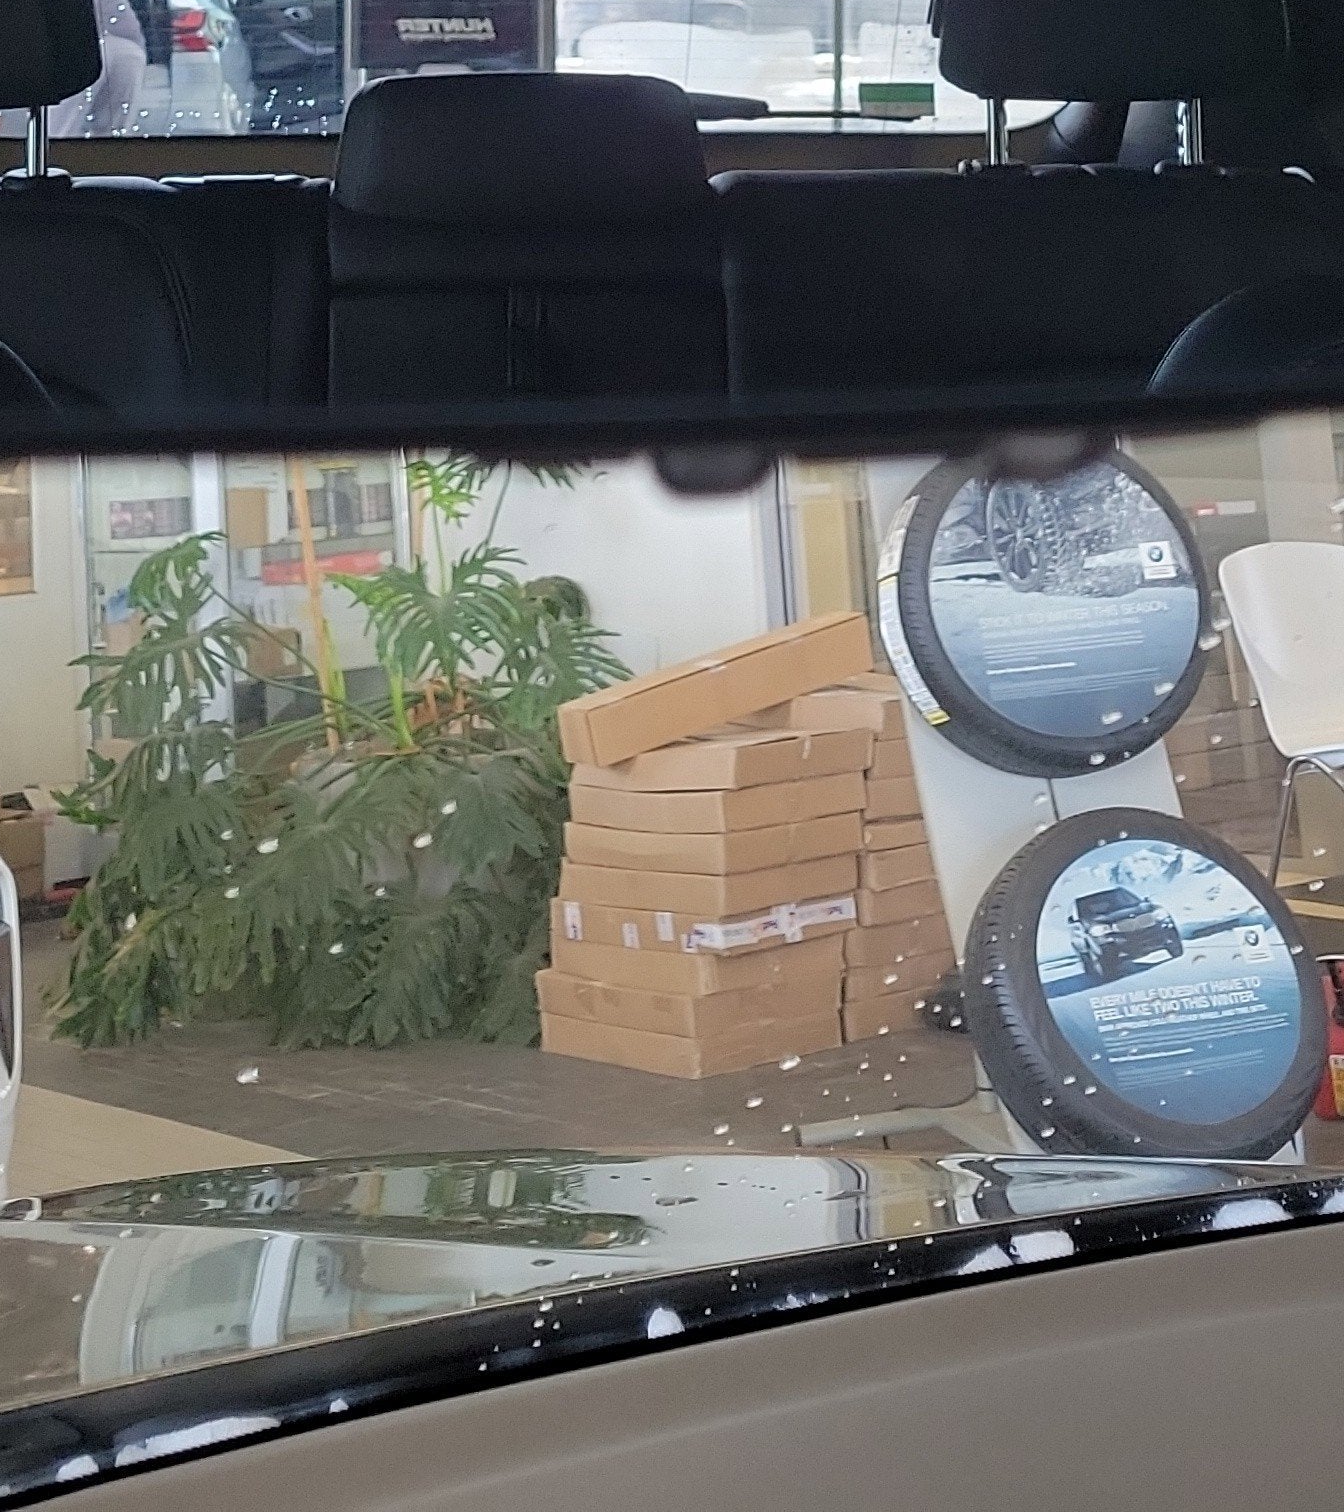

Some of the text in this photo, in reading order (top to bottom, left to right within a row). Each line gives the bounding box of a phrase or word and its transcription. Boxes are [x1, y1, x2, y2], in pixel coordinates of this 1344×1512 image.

[1090, 993, 1128, 1009] EVERY
[1128, 988, 1158, 1004] MILE
[1210, 976, 1245, 993] HAVE
[1244, 975, 1261, 989] TO
[1094, 1007, 1124, 1022] FEEL
[1124, 1003, 1152, 1018] LIKE
[1153, 999, 1180, 1015] TWO
[1182, 995, 1209, 1011] THIS
